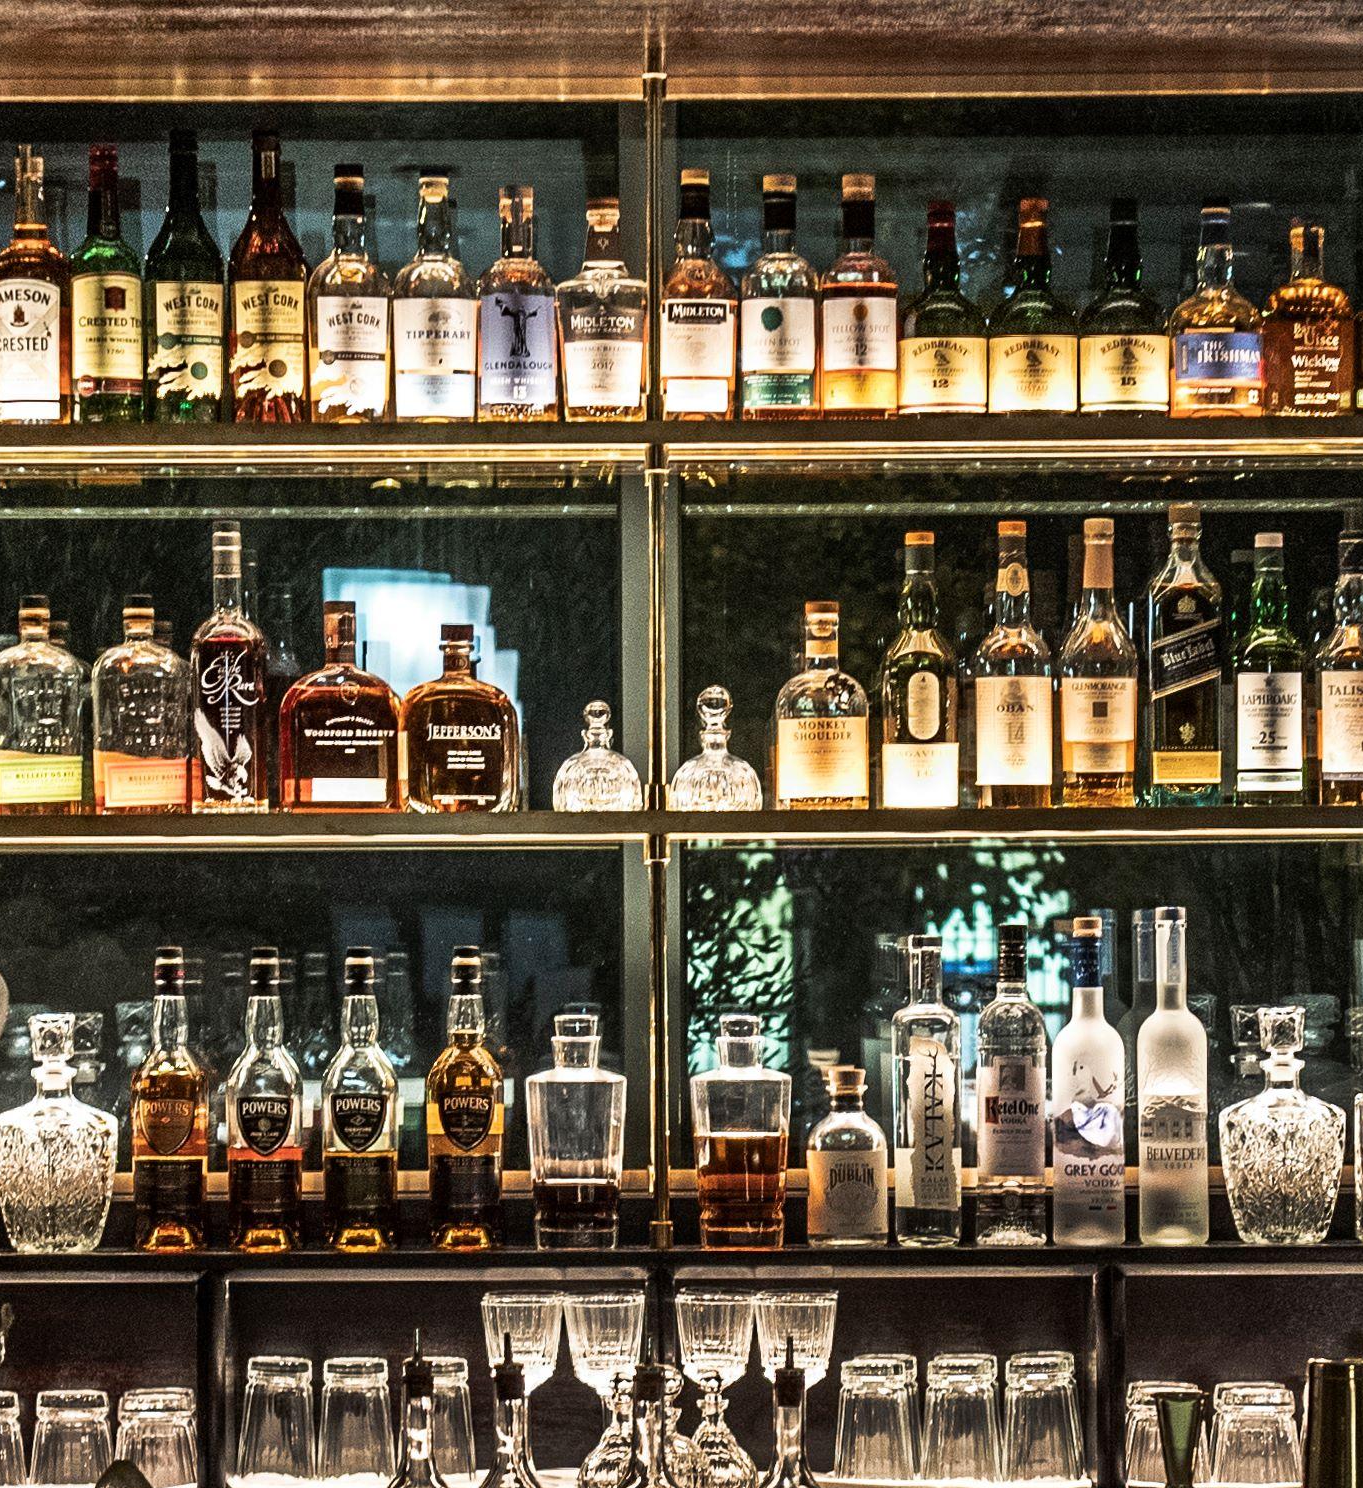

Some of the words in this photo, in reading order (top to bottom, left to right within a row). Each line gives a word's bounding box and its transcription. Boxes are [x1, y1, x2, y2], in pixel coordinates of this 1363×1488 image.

[163, 296, 192, 313] WEST
[195, 296, 220, 313] CORK
[241, 295, 270, 311] WEST
[273, 294, 299, 311] CORK
[671, 303, 724, 319] MIDLETON
[78, 315, 128, 328] CRESTED
[327, 312, 353, 328] WEST
[356, 312, 381, 329] CORK
[570, 314, 635, 331] MIDLETON
[406, 329, 472, 341] TIPPERARY
[868, 324, 890, 333] SPOT
[912, 338, 970, 357] REDBREAST
[1003, 338, 1061, 358] REDBREAST
[1099, 337, 1156, 355] REDBREAST
[1201, 340, 1225, 352] THE
[484, 361, 553, 372] GLENDALOUGH
[590, 360, 615, 372] 2017
[1291, 353, 1341, 369] Wicklow
[932, 379, 949, 388] 12
[1159, 648, 1186, 668] Blue
[1186, 637, 1216, 659] Label
[1071, 682, 1127, 691] GLENMORANGIE
[1241, 693, 1298, 706] LAPHROAIG
[996, 703, 1036, 713] OBAN
[426, 723, 502, 741] JEFFERSON'S
[797, 720, 847, 730] MONKEY
[304, 728, 354, 738] WOODFORD
[355, 729, 395, 738] RESERVE
[792, 731, 852, 741] SHOULDER
[1006, 721, 1025, 745] 14
[1258, 731, 1277, 745] 25
[143, 1101, 190, 1116] POWERS
[241, 1101, 288, 1116] POWERS
[335, 1098, 382, 1112] POWERS
[443, 1098, 489, 1112] POWERS
[986, 1099, 1018, 1120] Ketel
[1018, 1101, 1039, 1116] One
[924, 1072, 944, 1173] KALAK
[1064, 1163, 1095, 1177] GREY
[1099, 1163, 1125, 1177] GOO
[829, 1167, 875, 1190] DUBLIN
[1084, 1179, 1121, 1187] VODKA
